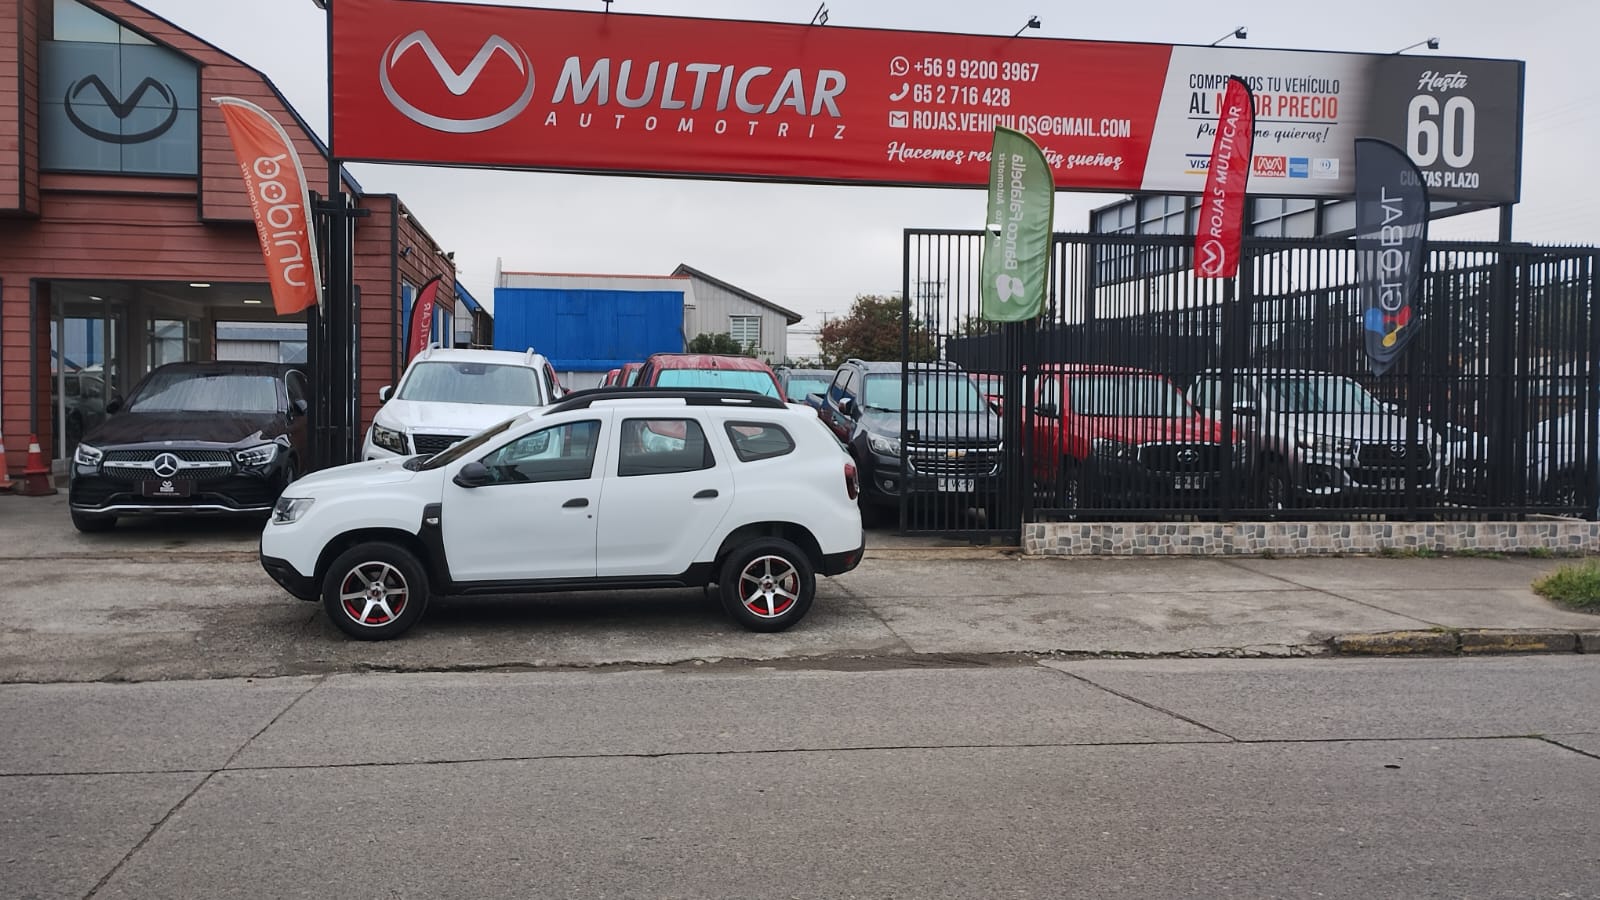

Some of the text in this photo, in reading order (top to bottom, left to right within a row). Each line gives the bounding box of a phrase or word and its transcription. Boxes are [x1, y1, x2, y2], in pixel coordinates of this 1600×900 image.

[914, 57, 1040, 82] +56 9 9200 3967
[1417, 70, 1468, 92] Hasta
[550, 55, 849, 118] MULTICAR
[913, 84, 1011, 107] 65 2 716 428
[1189, 73, 1340, 95] COMPROS TU VEHÍCULO
[1189, 92, 1210, 114] AL
[1278, 95, 1338, 119] PRECIO
[544, 111, 847, 140] AUTOMOTRIZ
[913, 110, 1131, 138] ROJAS.VEHICULOS@GMAIL.COM
[1274, 127, 1330, 143] quieras!
[1406, 94, 1475, 168] 60
[888, 141, 965, 165] Hacemos
[1041, 146, 1066, 169] tus
[1067, 150, 1124, 171] sueños
[1210, 105, 1242, 238] ROJAS MULTICAR
[1444, 171, 1479, 189] PLAZO
